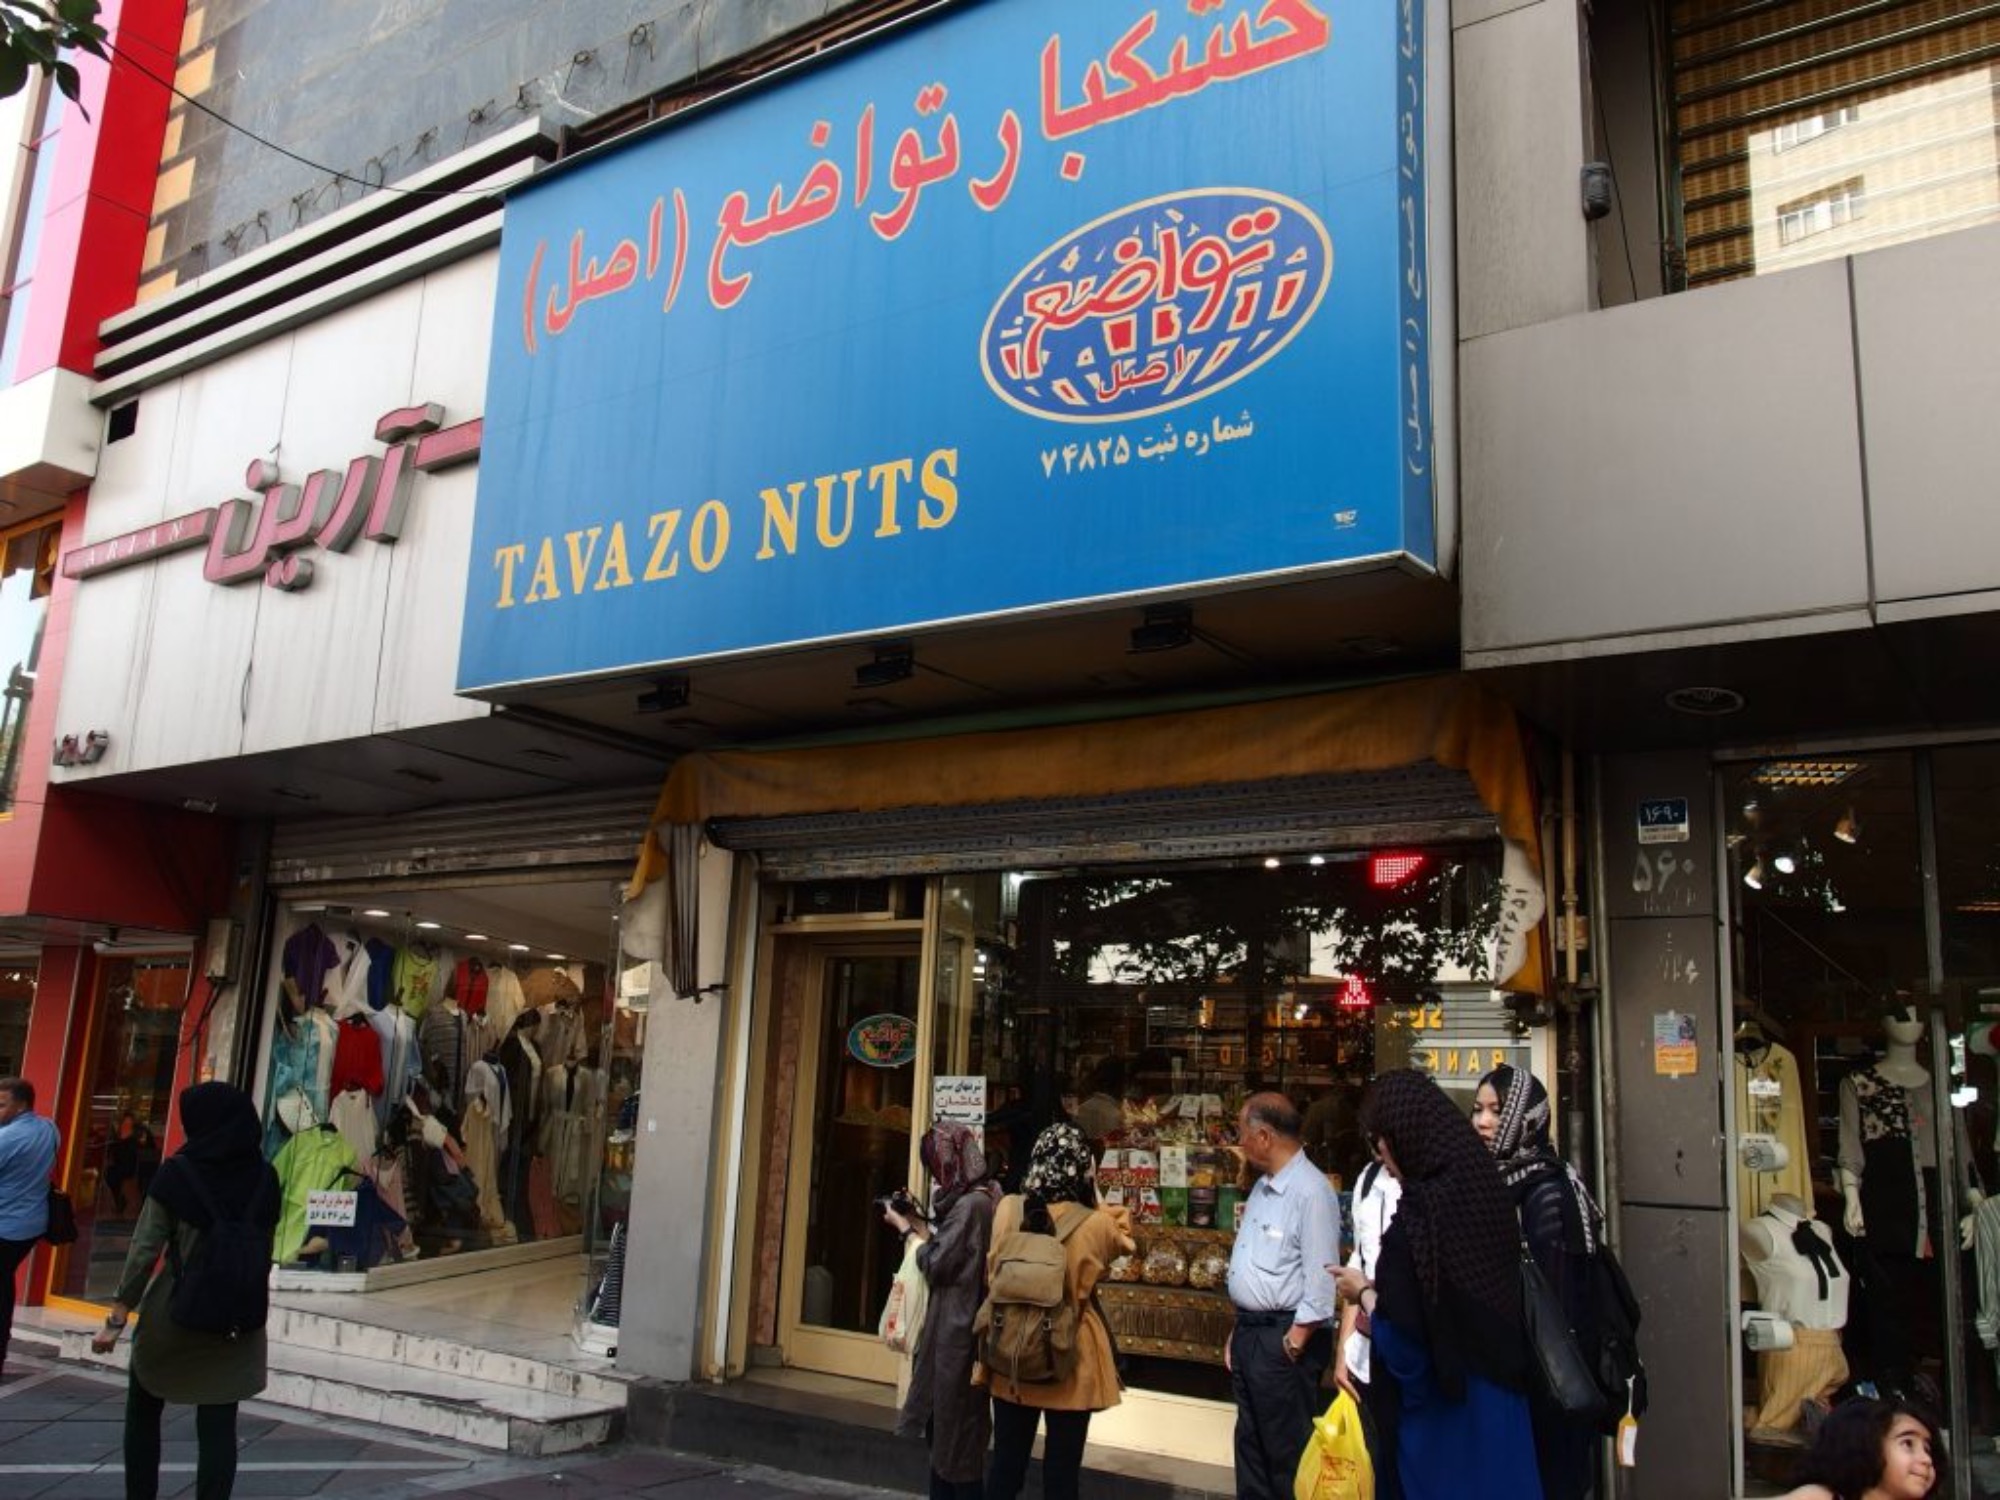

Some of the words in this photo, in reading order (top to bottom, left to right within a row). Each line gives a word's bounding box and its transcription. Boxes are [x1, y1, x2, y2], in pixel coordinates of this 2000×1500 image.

[708, 82, 961, 309] تواضع
[1021, 206, 1281, 378] تواضع
[1137, 422, 1178, 460] ثبت
[1184, 409, 1255, 456] شماره
[1040, 435, 1131, 479] ۷۴۸۲۵
[203, 402, 445, 591] آرین
[493, 499, 731, 609] TAVAZO
[756, 448, 960, 562] NUTS
[1645, 805, 1679, 823] ۱۶۹۰
[1632, 849, 1696, 894] ۵۶۰
